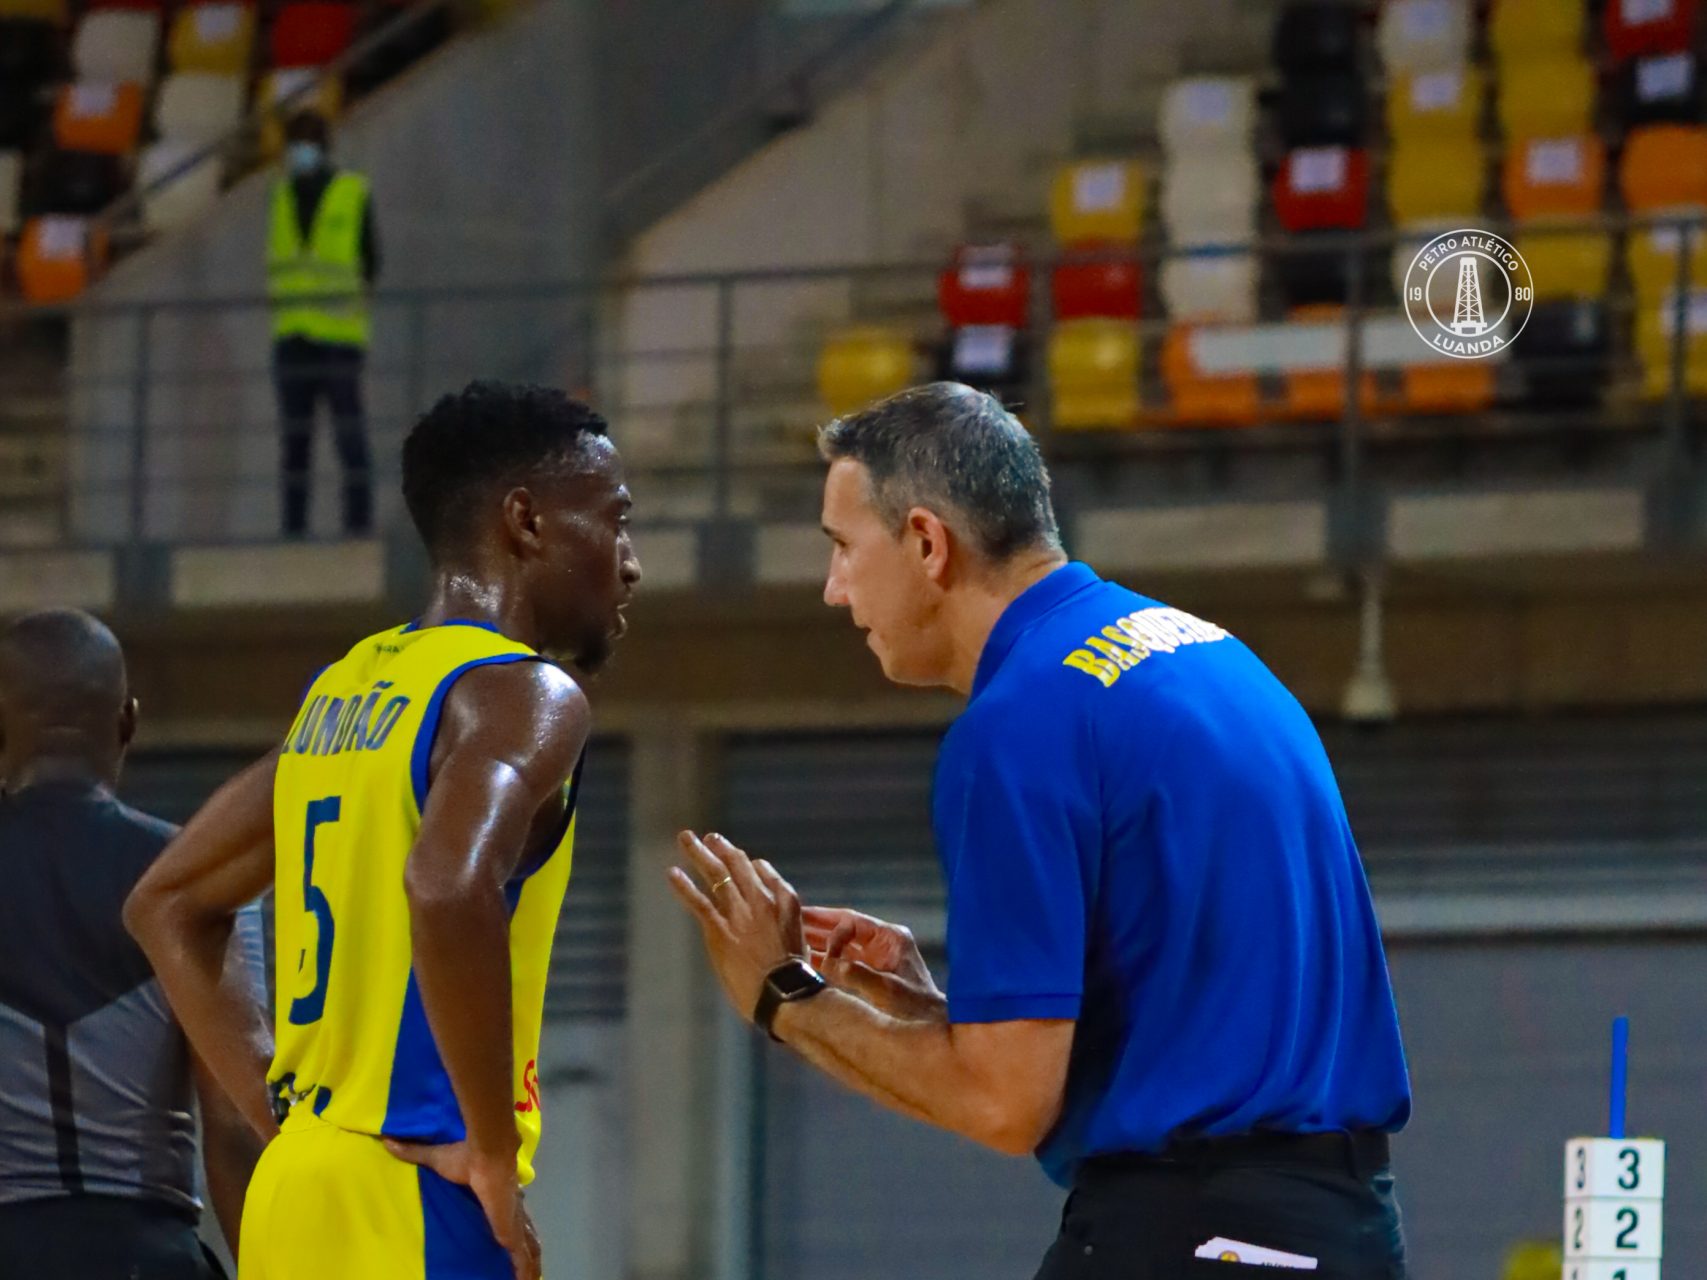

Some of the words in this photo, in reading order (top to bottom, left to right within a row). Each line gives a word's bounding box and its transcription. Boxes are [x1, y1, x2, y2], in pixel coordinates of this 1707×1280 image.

[288, 796, 342, 1026] 5
[1575, 1146, 1586, 1189] 3
[1617, 1148, 1640, 1191] 3
[1572, 1207, 1583, 1249] 2
[1616, 1207, 1639, 1250] 2
